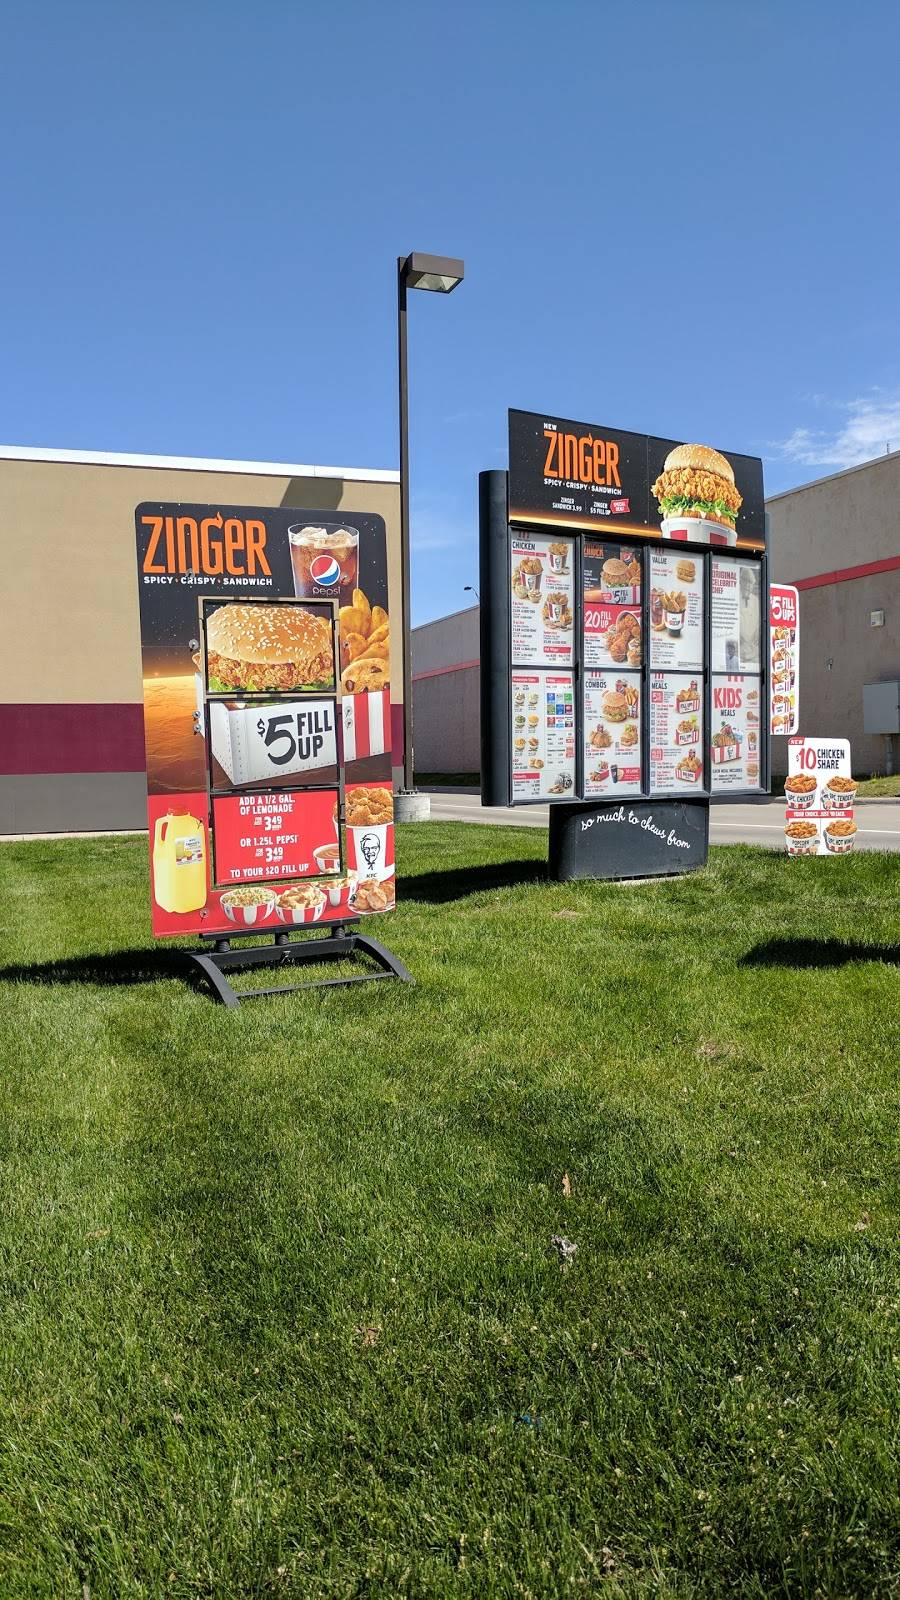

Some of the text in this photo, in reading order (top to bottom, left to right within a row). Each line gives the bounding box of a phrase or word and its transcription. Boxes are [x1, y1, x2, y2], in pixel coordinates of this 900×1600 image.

[544, 433, 622, 487] ZINGER
[544, 479, 622, 495] SPICY CRISPY SANDWICH
[142, 512, 272, 576] ZINGER
[512, 542, 536, 550] CHICKEN
[652, 556, 667, 565] VALUE
[712, 570, 737, 580] ORIGINAL
[144, 576, 272, 586] SPICY CRISPY SANDWICH
[712, 579, 737, 587] CELEBRITY
[782, 597, 794, 609] FILL
[600, 610, 612, 620] FILL
[782, 609, 795, 621] UPS
[600, 619, 609, 628] UP
[585, 681, 607, 689] COMBOS
[651, 682, 667, 690] MEALS
[714, 688, 742, 709] KIDS
[720, 709, 736, 717] MEALS
[297, 710, 332, 736] FILL
[257, 714, 296, 766] $5
[298, 735, 323, 760] UP
[796, 748, 816, 769] $10
[817, 749, 845, 759] CHICKEN
[817, 760, 839, 769] SHARE
[239, 794, 295, 805] ADD A 1/2 GAL.
[240, 804, 293, 815] OF LEMONADE
[581, 806, 690, 848] so much to chews from
[240, 835, 297, 847] OR 1.25L PEPSI
[230, 864, 309, 878] TO YOUR $20 FILL UP
